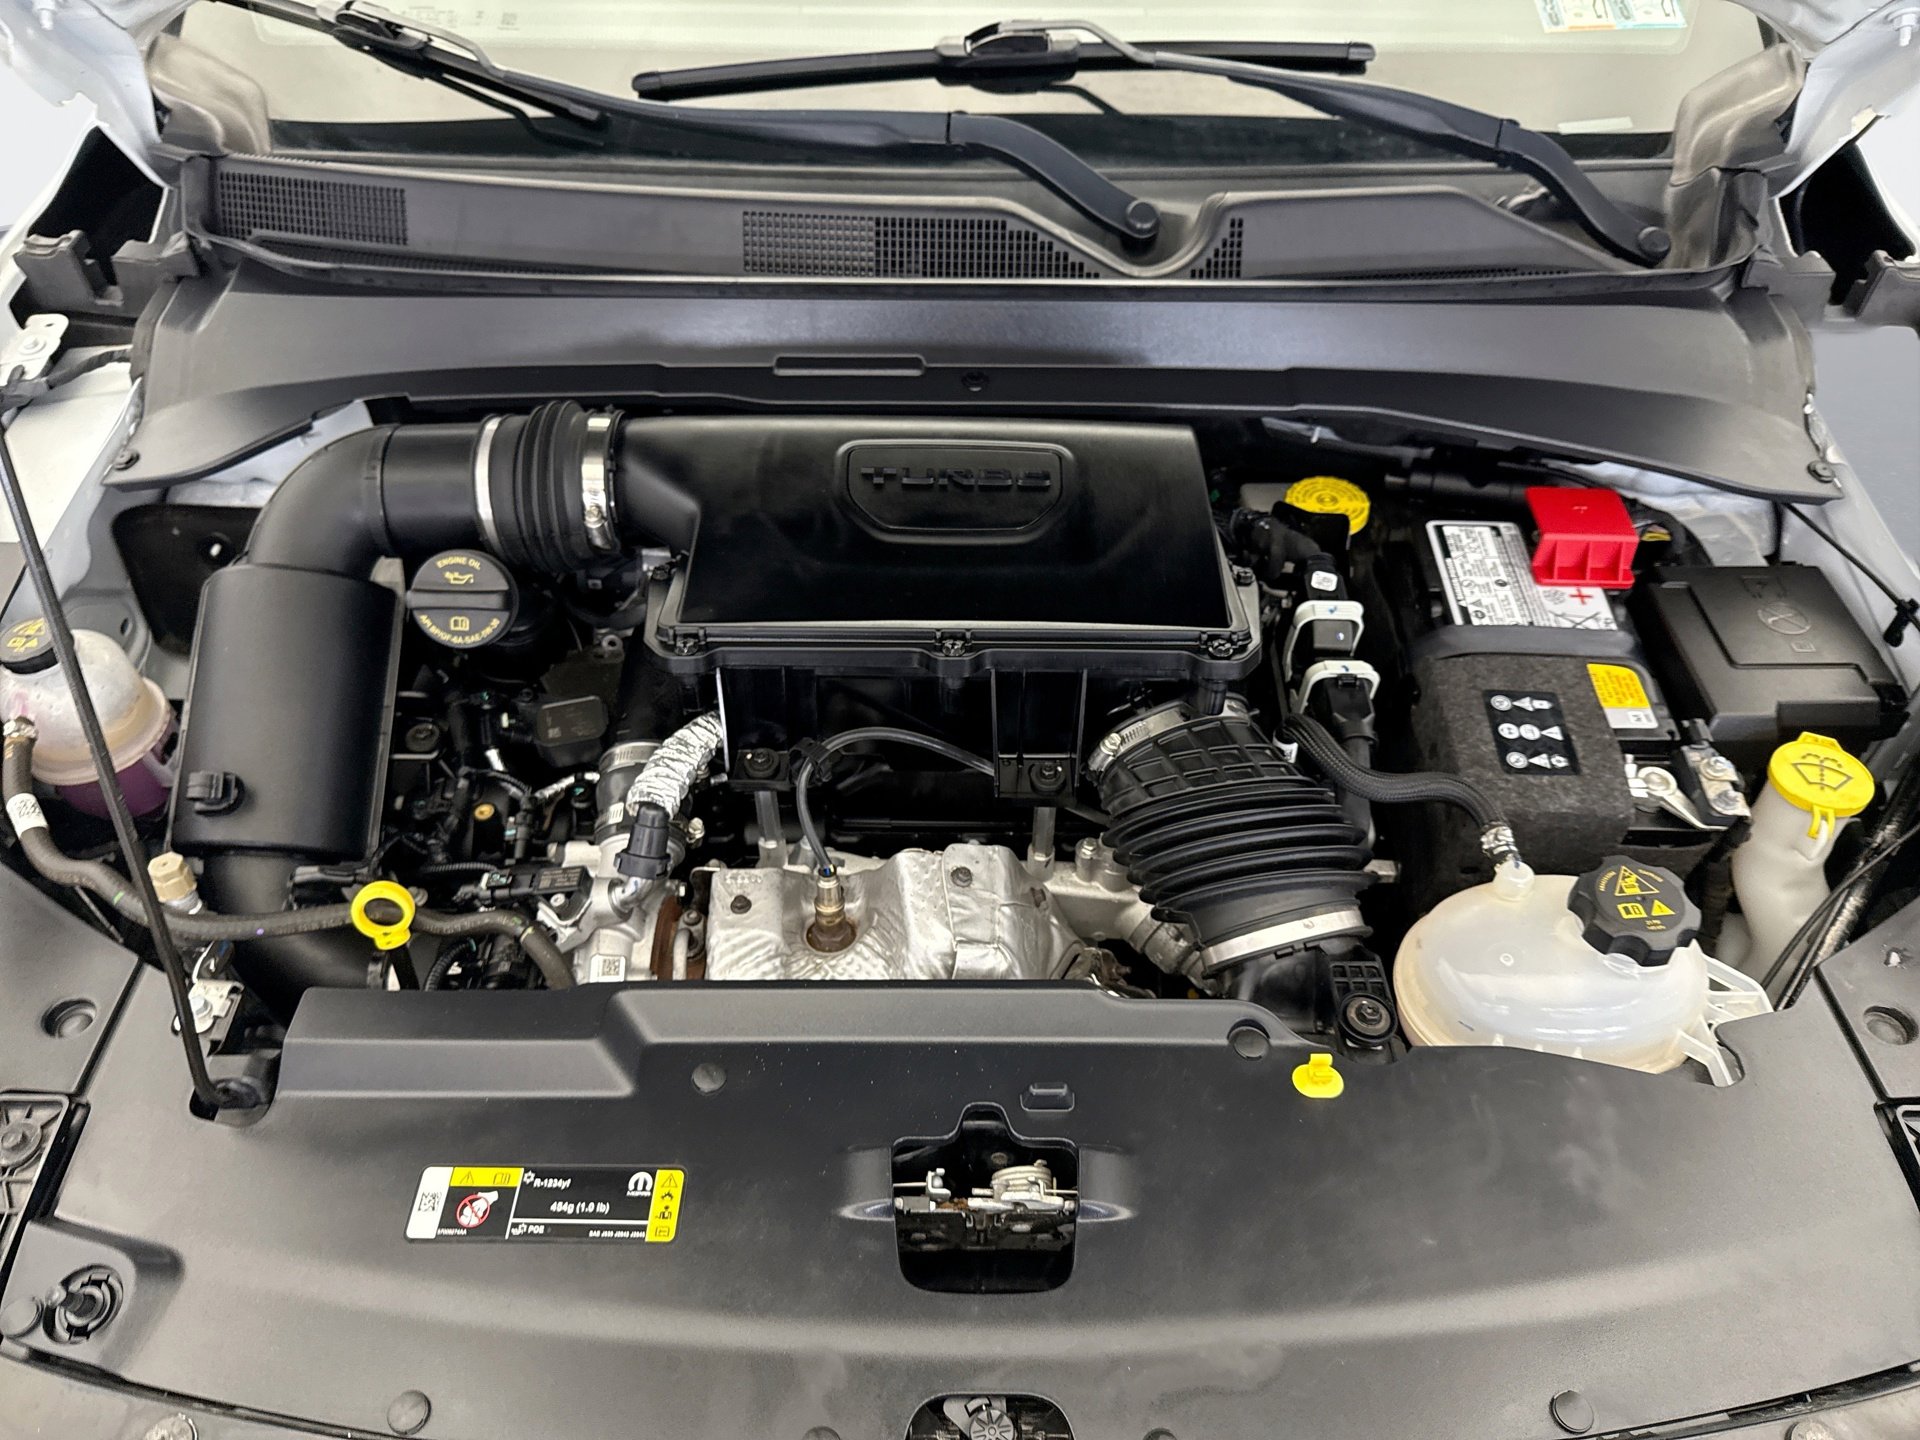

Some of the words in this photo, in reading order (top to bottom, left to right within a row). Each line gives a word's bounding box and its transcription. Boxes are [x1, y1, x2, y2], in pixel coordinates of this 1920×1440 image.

[861, 467, 1050, 486] TURBO
[436, 556, 467, 568] ENGINE
[468, 559, 481, 571] OIL
[533, 1178, 572, 1190] R-1234yf
[550, 1201, 575, 1215] 454g
[576, 1201, 595, 1214] (1.0
[596, 1202, 610, 1215] lb)
[528, 1225, 545, 1234] POE
